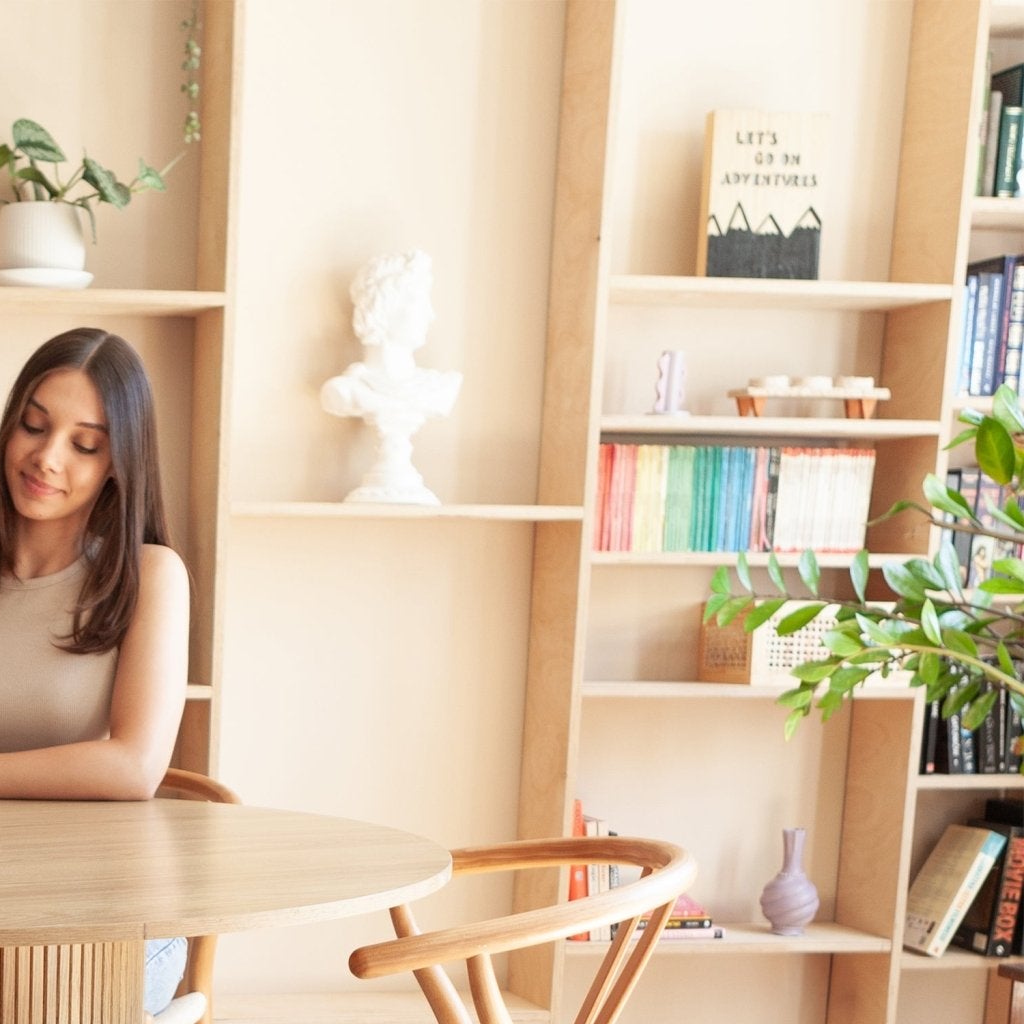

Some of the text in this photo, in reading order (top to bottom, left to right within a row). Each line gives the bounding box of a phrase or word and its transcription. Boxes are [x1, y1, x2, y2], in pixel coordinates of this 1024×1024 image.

[736, 131, 778, 145] LET'S
[754, 152, 801, 165] GO ON
[721, 173, 818, 187] ADVENTURES
[993, 901, 1018, 941] BOX
